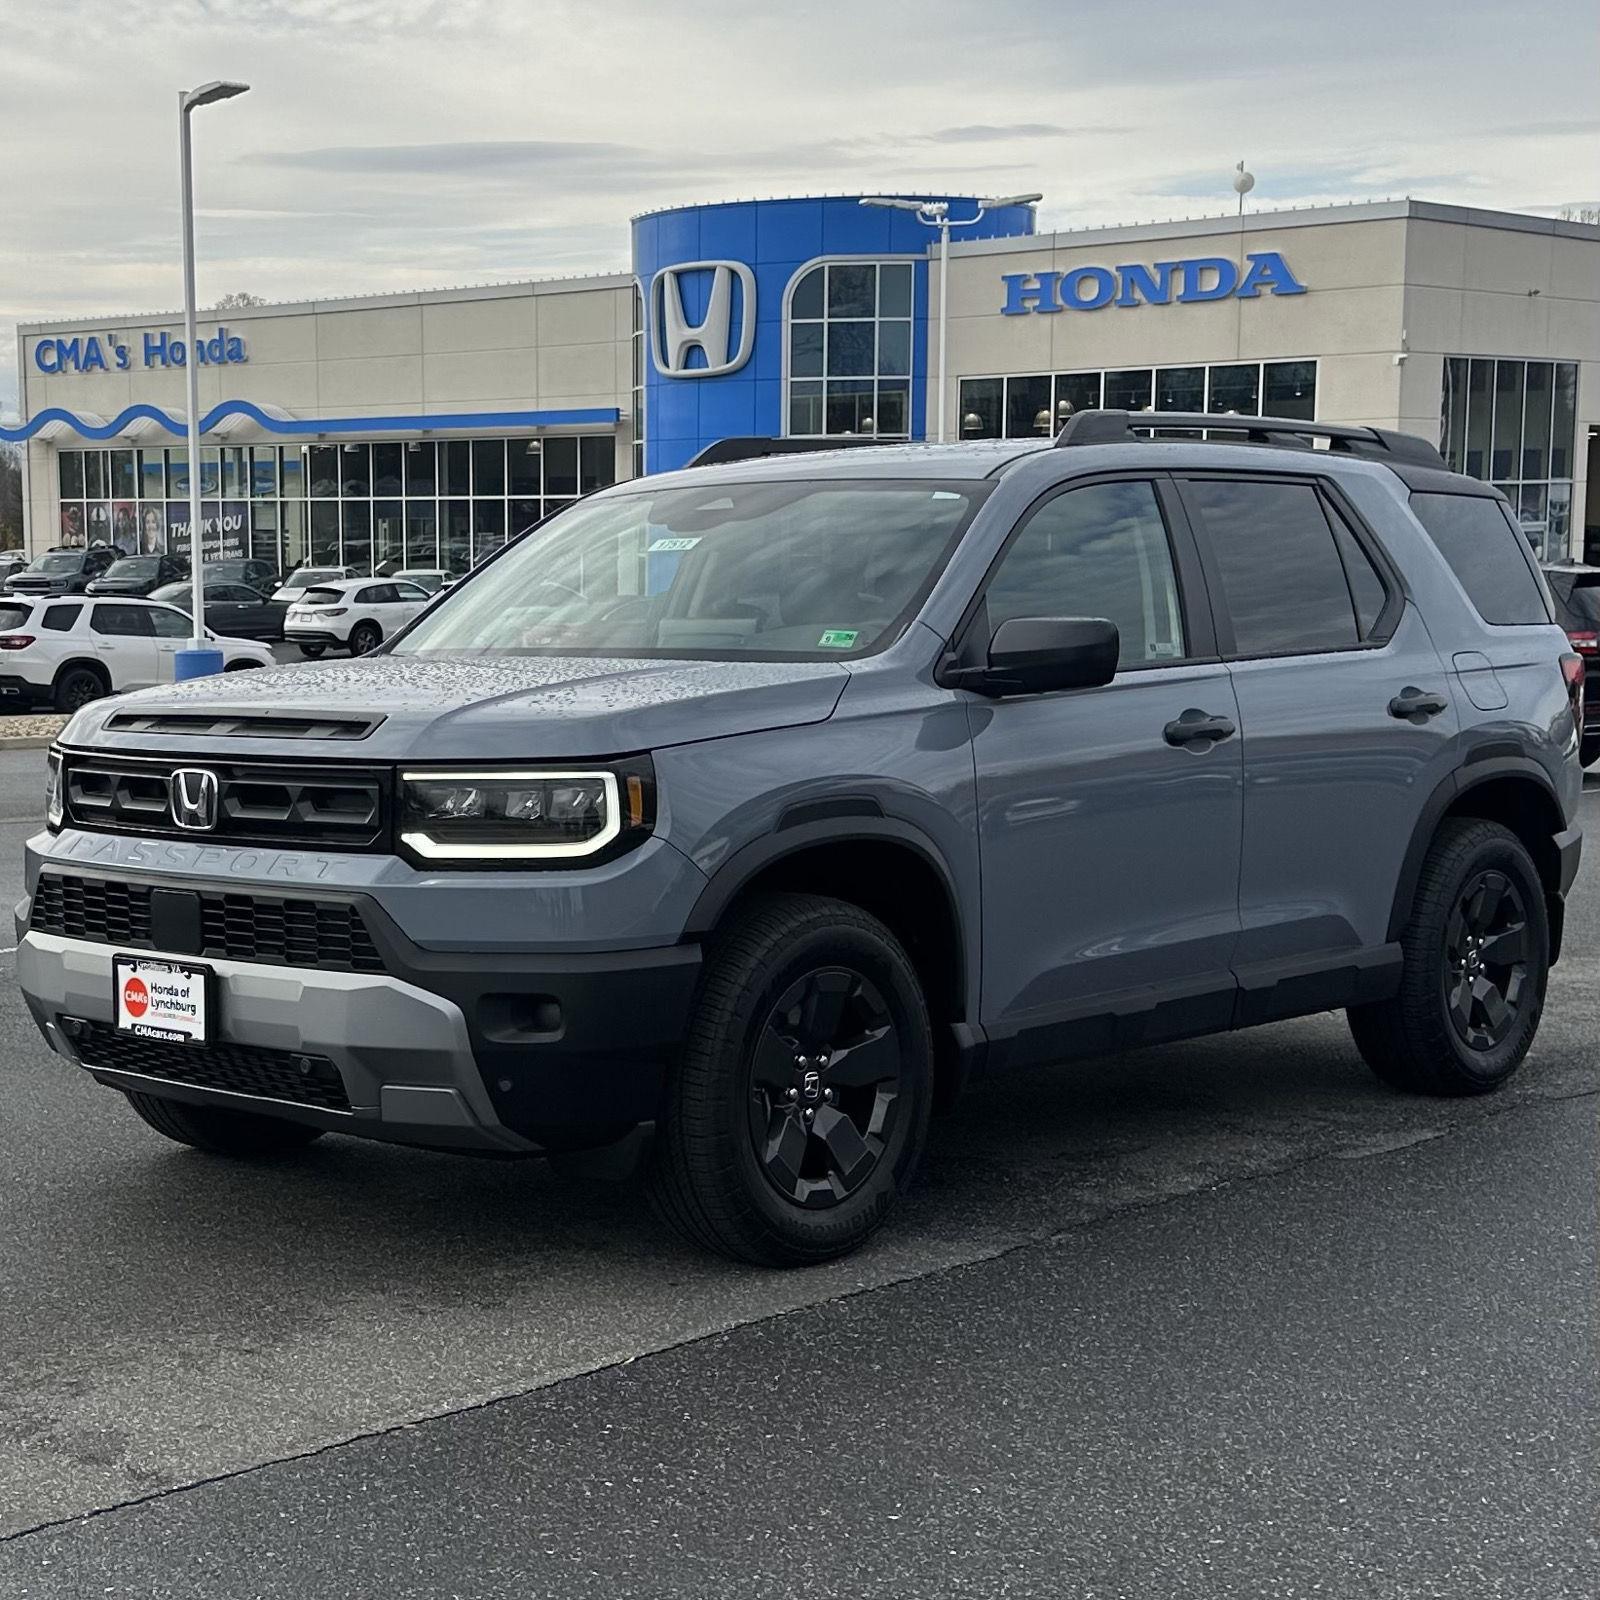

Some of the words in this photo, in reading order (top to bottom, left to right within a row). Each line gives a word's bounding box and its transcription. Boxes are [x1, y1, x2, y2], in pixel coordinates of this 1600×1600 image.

[1000, 250, 1307, 316] HONDA
[35, 333, 131, 374] CMA's
[215, 514, 242, 533] YOU
[67, 835, 348, 880] PASSPORT
[151, 982, 179, 998] Honda
[180, 986, 191, 999] of
[150, 997, 197, 1017] Lynchburg
[134, 1024, 185, 1043] CMAcars.com
